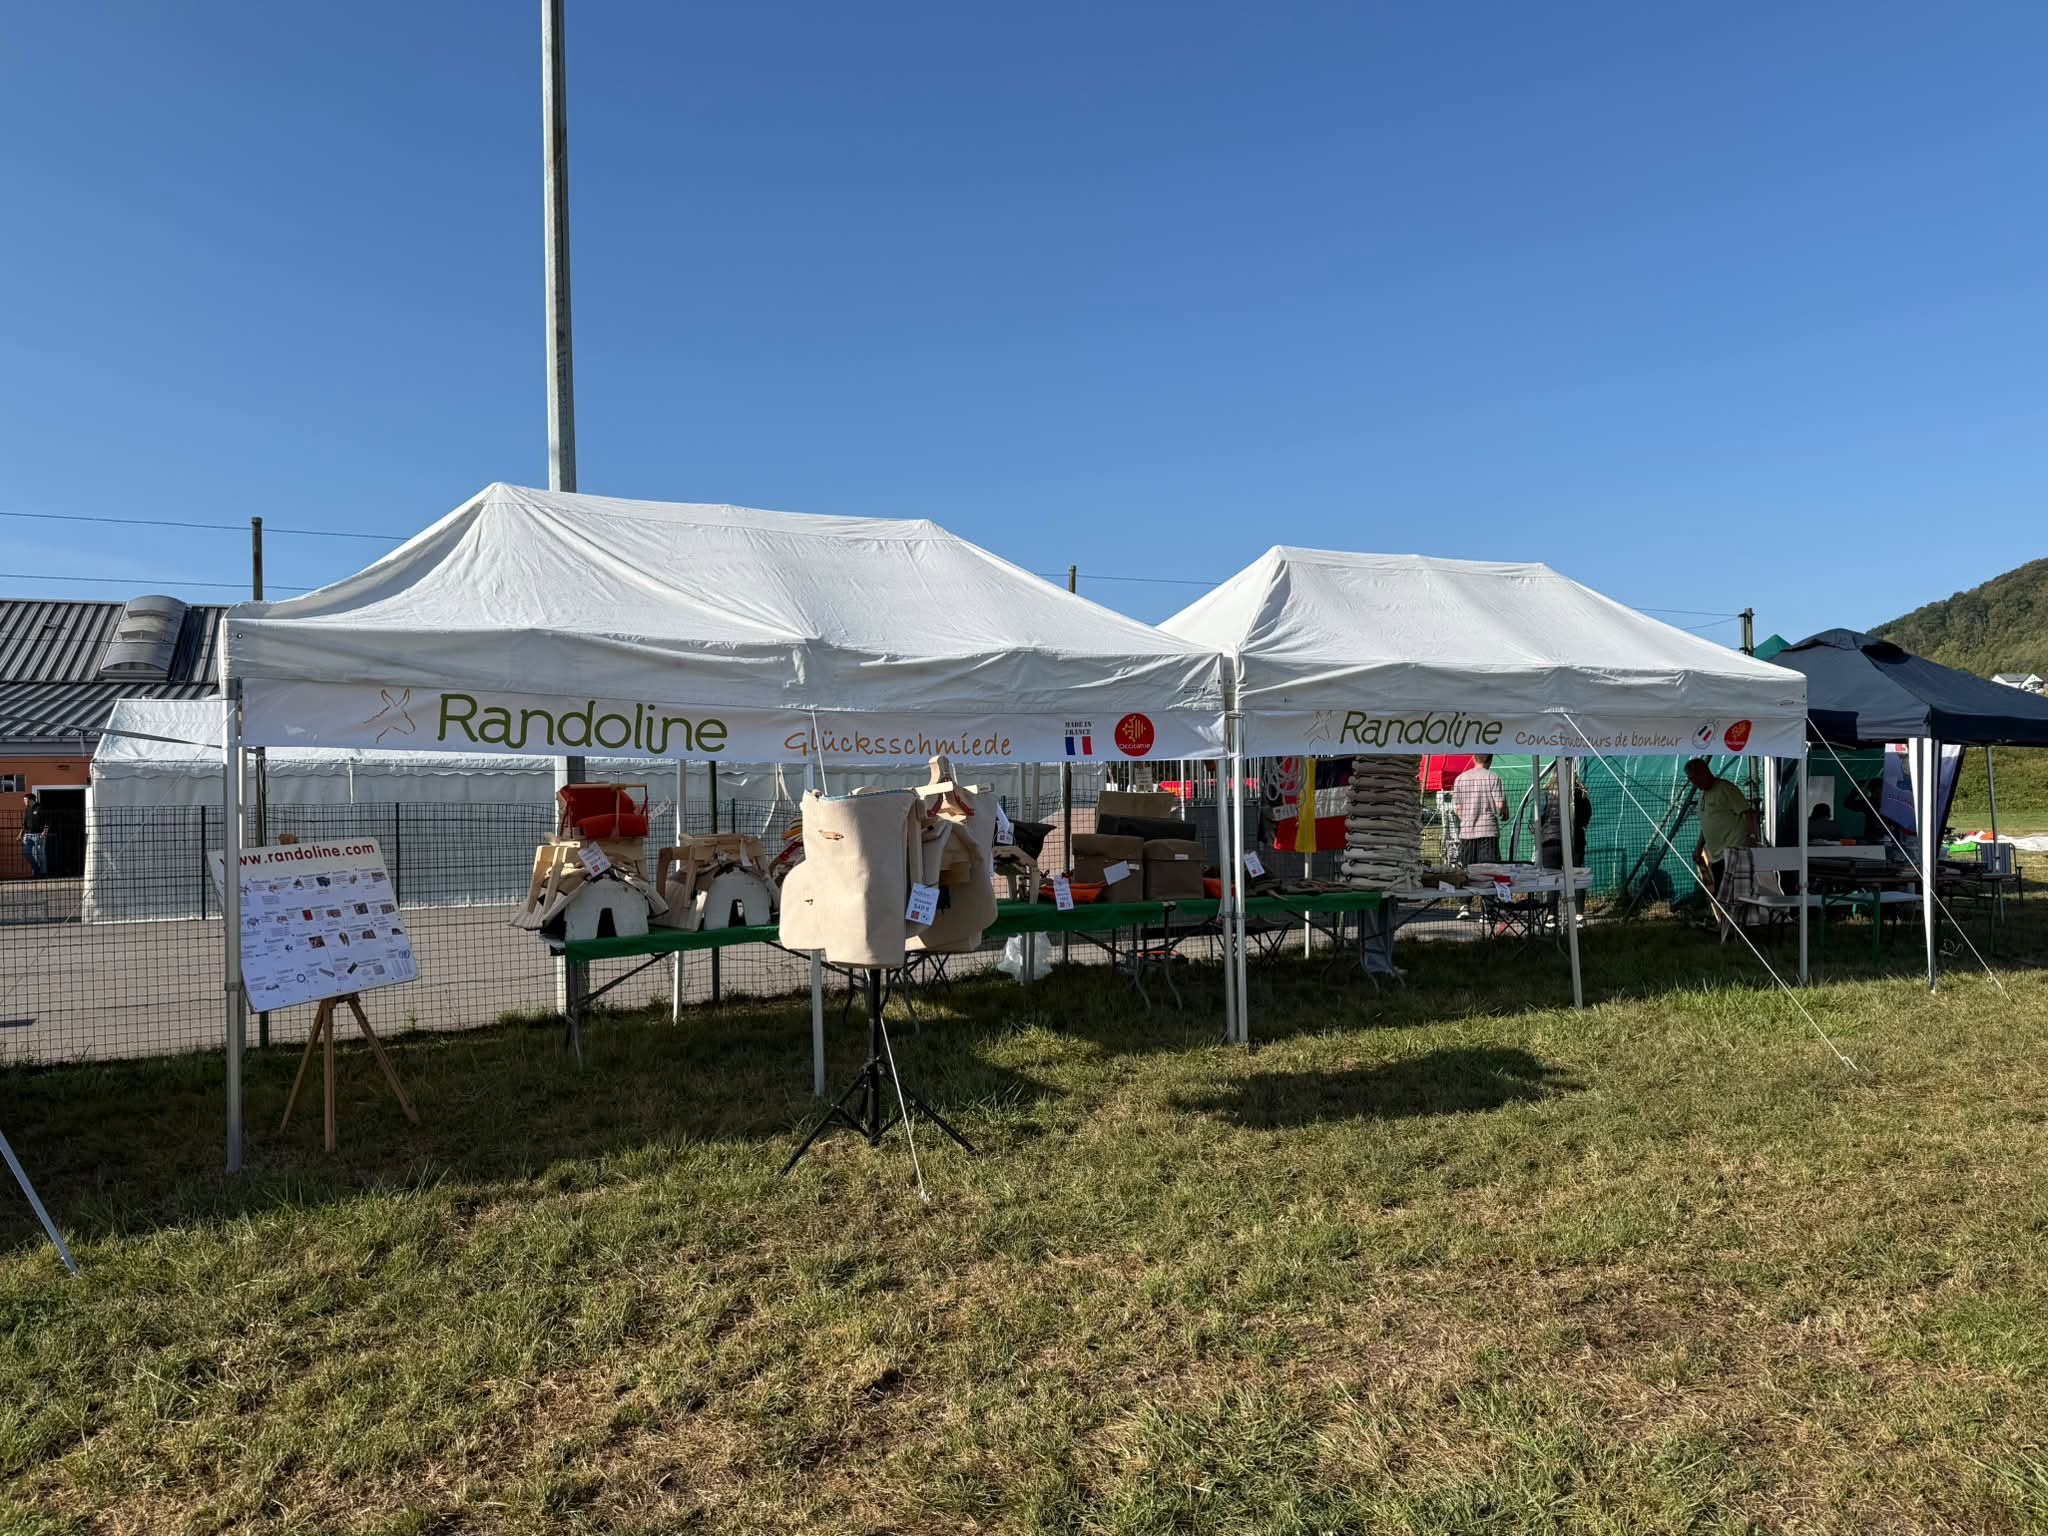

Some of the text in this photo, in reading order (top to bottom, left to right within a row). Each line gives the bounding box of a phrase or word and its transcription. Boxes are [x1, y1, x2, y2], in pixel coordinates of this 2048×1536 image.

[437, 693, 728, 755] Randoline
[1339, 710, 1503, 748] Randoline
[784, 731, 1012, 757] Glücksschmiede
[1614, 731, 1630, 747] de
[1631, 732, 1682, 748] bonheur
[219, 843, 375, 866] ww.randoline.com
